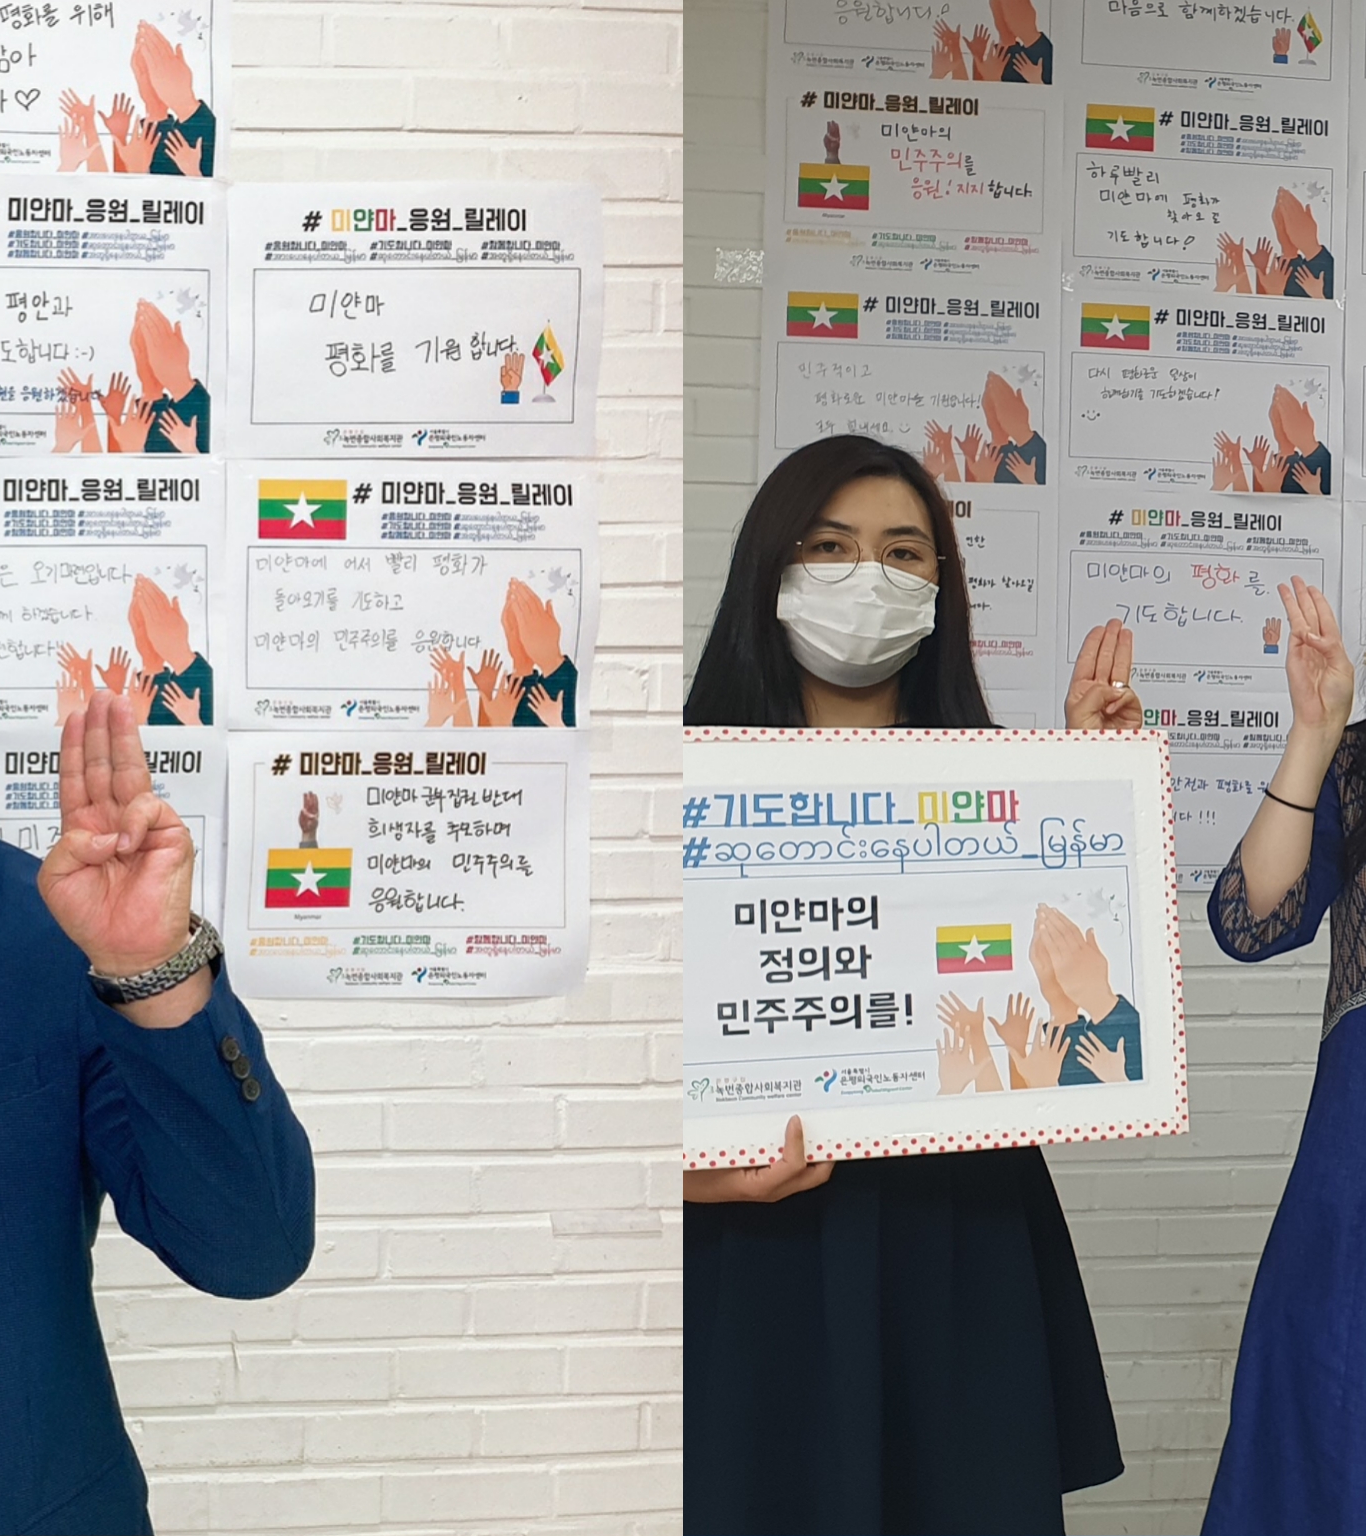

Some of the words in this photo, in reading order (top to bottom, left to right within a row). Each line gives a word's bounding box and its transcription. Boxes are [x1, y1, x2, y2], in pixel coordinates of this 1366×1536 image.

[69, 2, 114, 28] 위해
[801, 91, 817, 107] #
[824, 91, 978, 116] 미얀마_응원_릴레이
[881, 123, 951, 142] 미얀마의
[891, 147, 976, 176] 민주주의를
[8, 198, 203, 225] 미얀마_응원_릴레이
[302, 211, 322, 232] #
[332, 208, 526, 231] 미얀마_응원_릴레이
[5, 291, 73, 323] 평안과
[309, 290, 385, 320] 미얀마
[325, 342, 396, 377] 평화를
[352, 483, 372, 504] #
[382, 482, 572, 506] 미얀마_응원_릴레이
[1109, 510, 1124, 525] #
[1132, 510, 1281, 531] 미얀마_응원_릴레이
[1087, 563, 1170, 584] 미얀마의
[272, 754, 292, 775] #
[300, 752, 486, 775] 미얀마_응원_릴레이
[367, 787, 418, 807] 미얀마
[683, 790, 1021, 828] #기도합니다_미얀마
[452, 853, 533, 879] 민주주의를
[368, 887, 464, 913] 응원합니다.
[735, 896, 878, 934] 미얀마의
[760, 945, 872, 983] 정의와
[718, 992, 912, 1036] 민주주의를!
